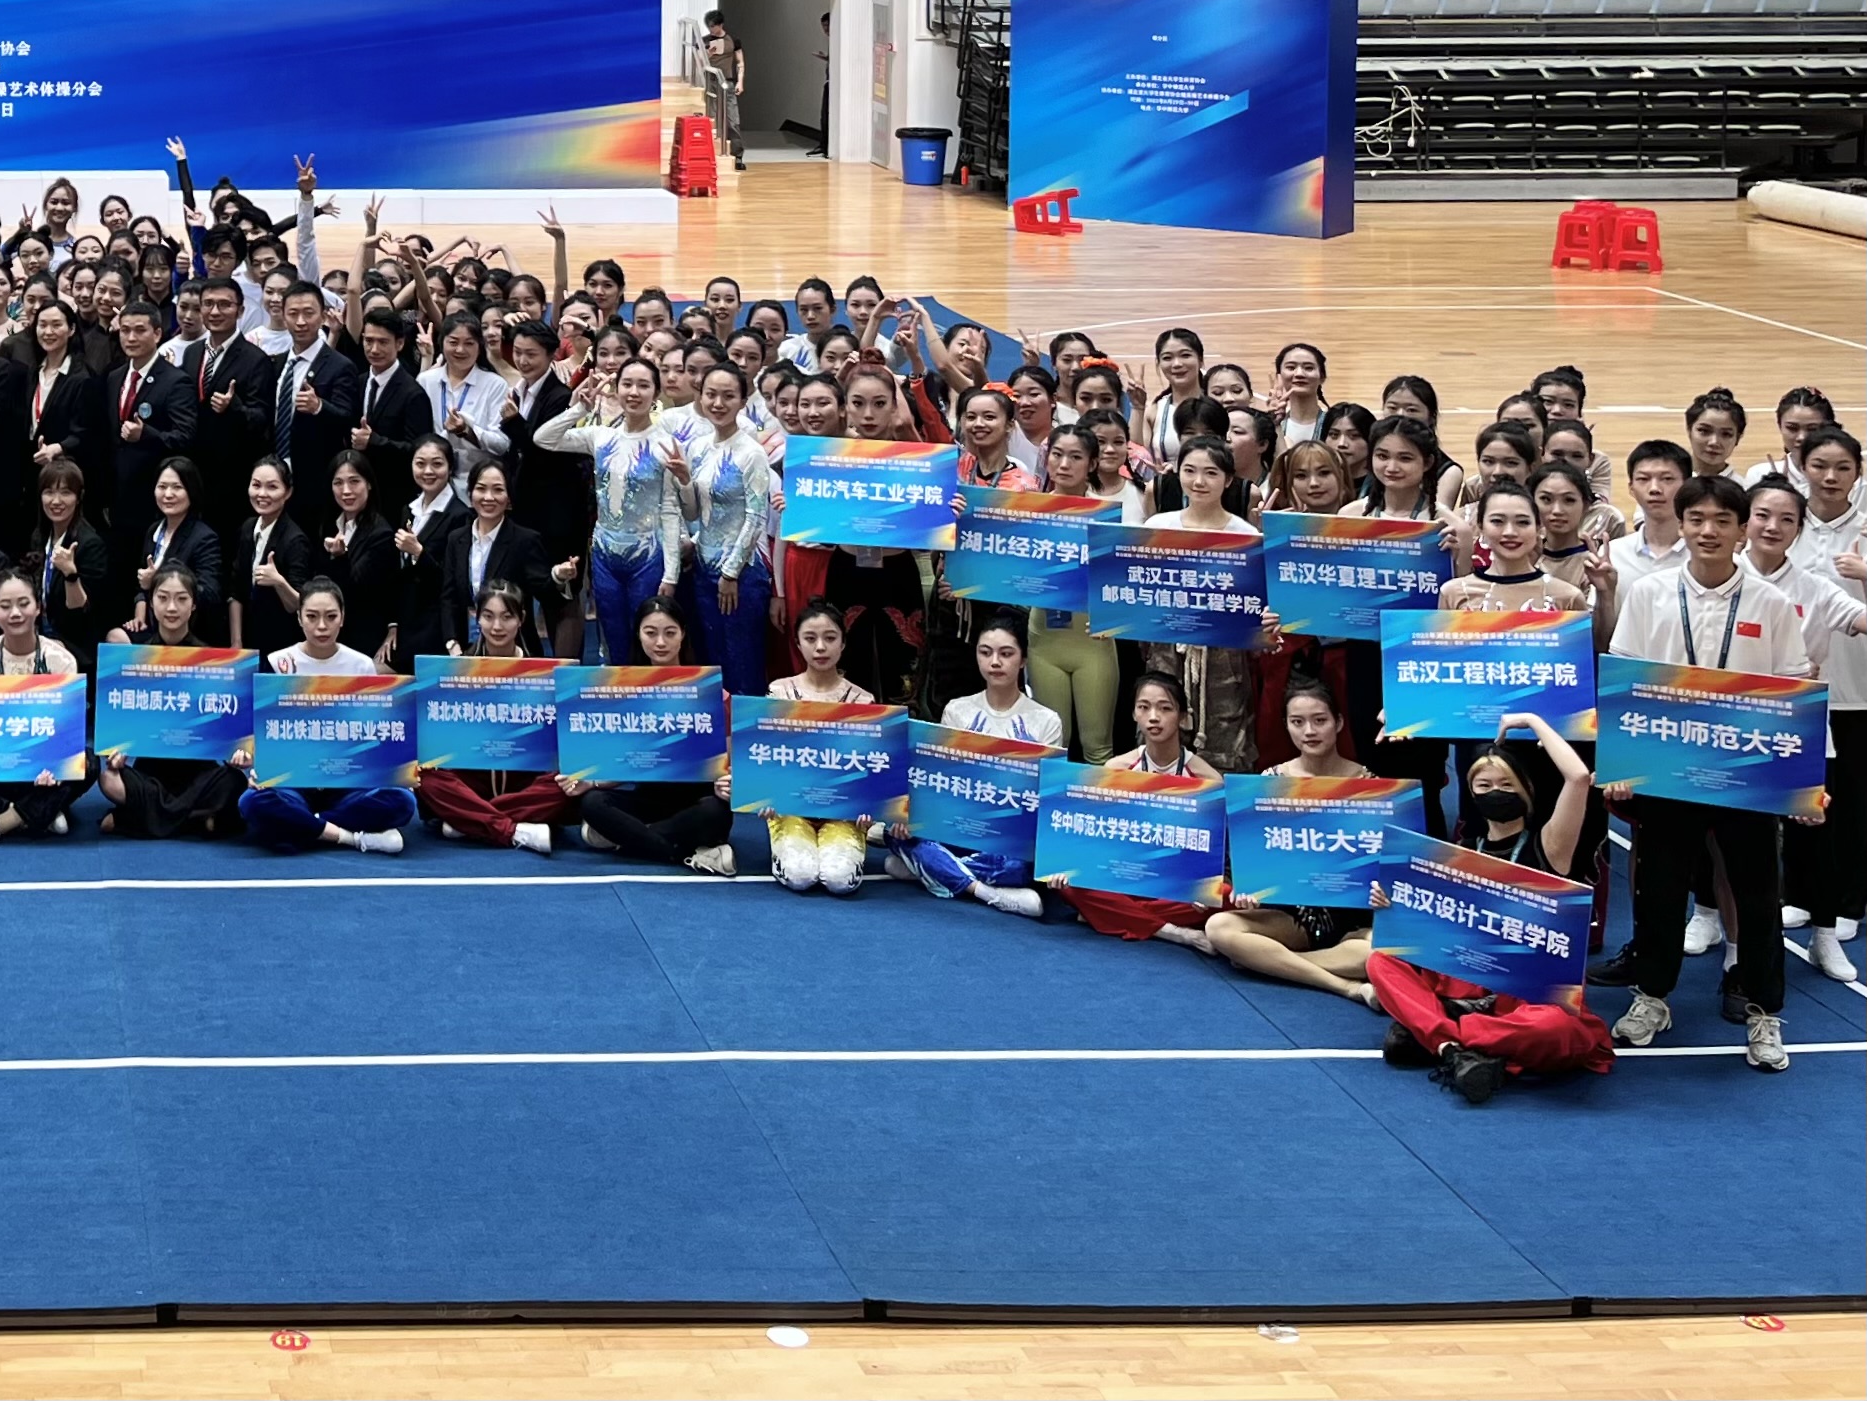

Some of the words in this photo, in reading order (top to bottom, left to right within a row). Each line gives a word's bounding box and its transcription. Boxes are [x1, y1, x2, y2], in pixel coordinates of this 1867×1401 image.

[795, 477, 944, 505] 湖北汽车工业学院
[1127, 565, 1235, 591] 武汉工程大学
[1278, 561, 1439, 594] 武汉华夏理工学院
[1101, 584, 1262, 615] 邮电与信息工程学院
[1397, 660, 1578, 687] 武汉工程科技学院
[108, 689, 239, 715] 中国地质大学（武汉）
[265, 719, 406, 742] 湖北铁道运输职业学院
[568, 711, 713, 735] 武汉职业技术学院
[1618, 710, 1803, 758] 华中师范大学
[748, 742, 891, 774] 华中农业大学
[907, 766, 1040, 812] 华中科技大学
[1050, 809, 1211, 853] 华中师范大学学生艺术团舞蹈团
[1263, 826, 1384, 854] 湖北大学
[1390, 880, 1571, 959] 武汉设计工程学院
